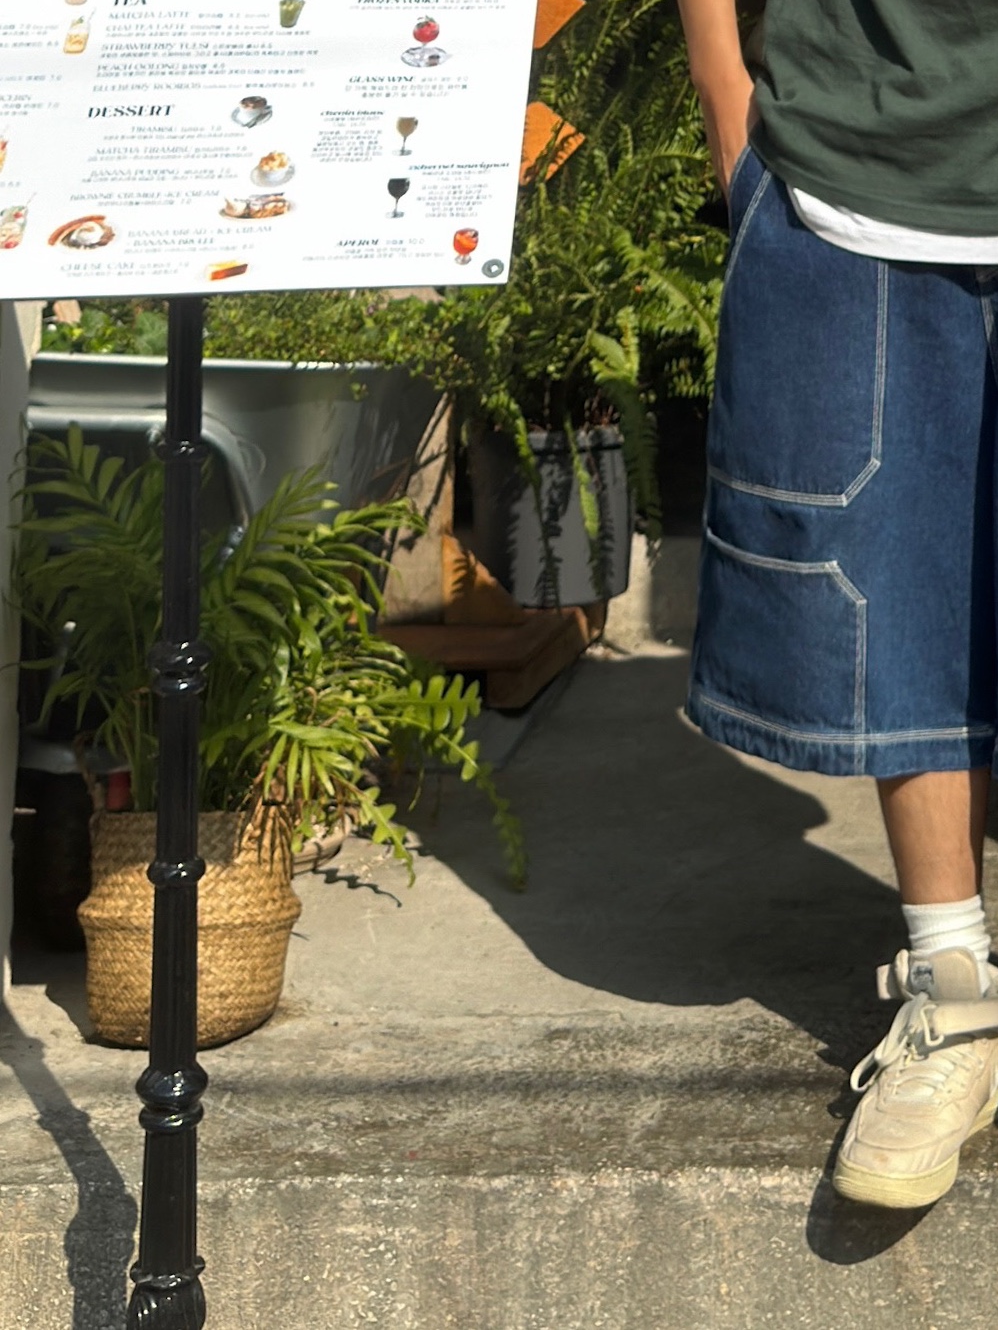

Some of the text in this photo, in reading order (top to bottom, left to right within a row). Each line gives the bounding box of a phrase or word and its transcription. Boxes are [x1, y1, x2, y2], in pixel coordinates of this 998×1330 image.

[108, 11, 156, 20] MATCHA
[157, 11, 190, 19] LATTE
[87, 104, 175, 119] DESSERT
